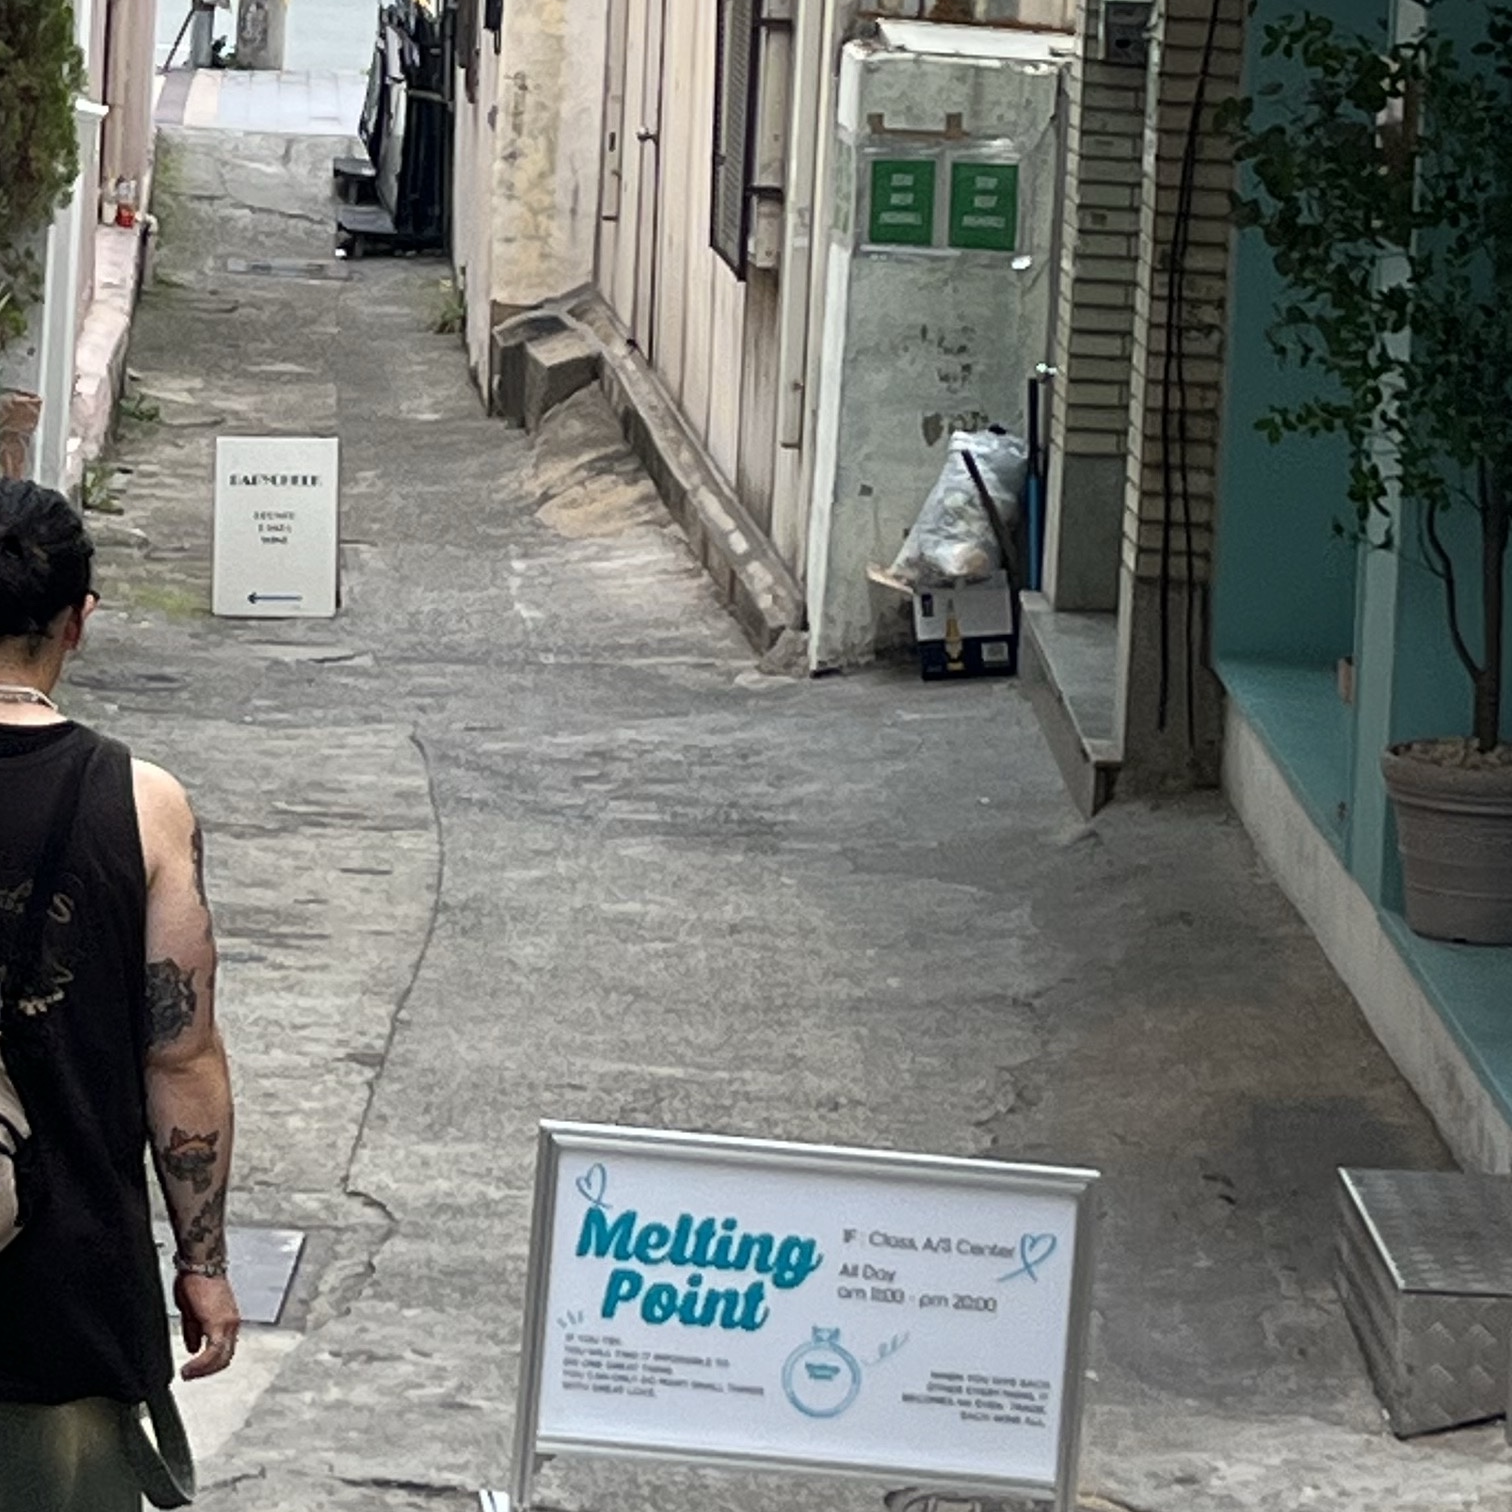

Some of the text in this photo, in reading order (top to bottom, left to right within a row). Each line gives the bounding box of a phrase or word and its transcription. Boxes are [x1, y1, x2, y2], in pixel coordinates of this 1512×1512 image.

[575, 1206, 823, 1289] Melting
[862, 1263, 897, 1283] Day
[601, 1268, 770, 1331] Point
[918, 1293, 949, 1308] pm
